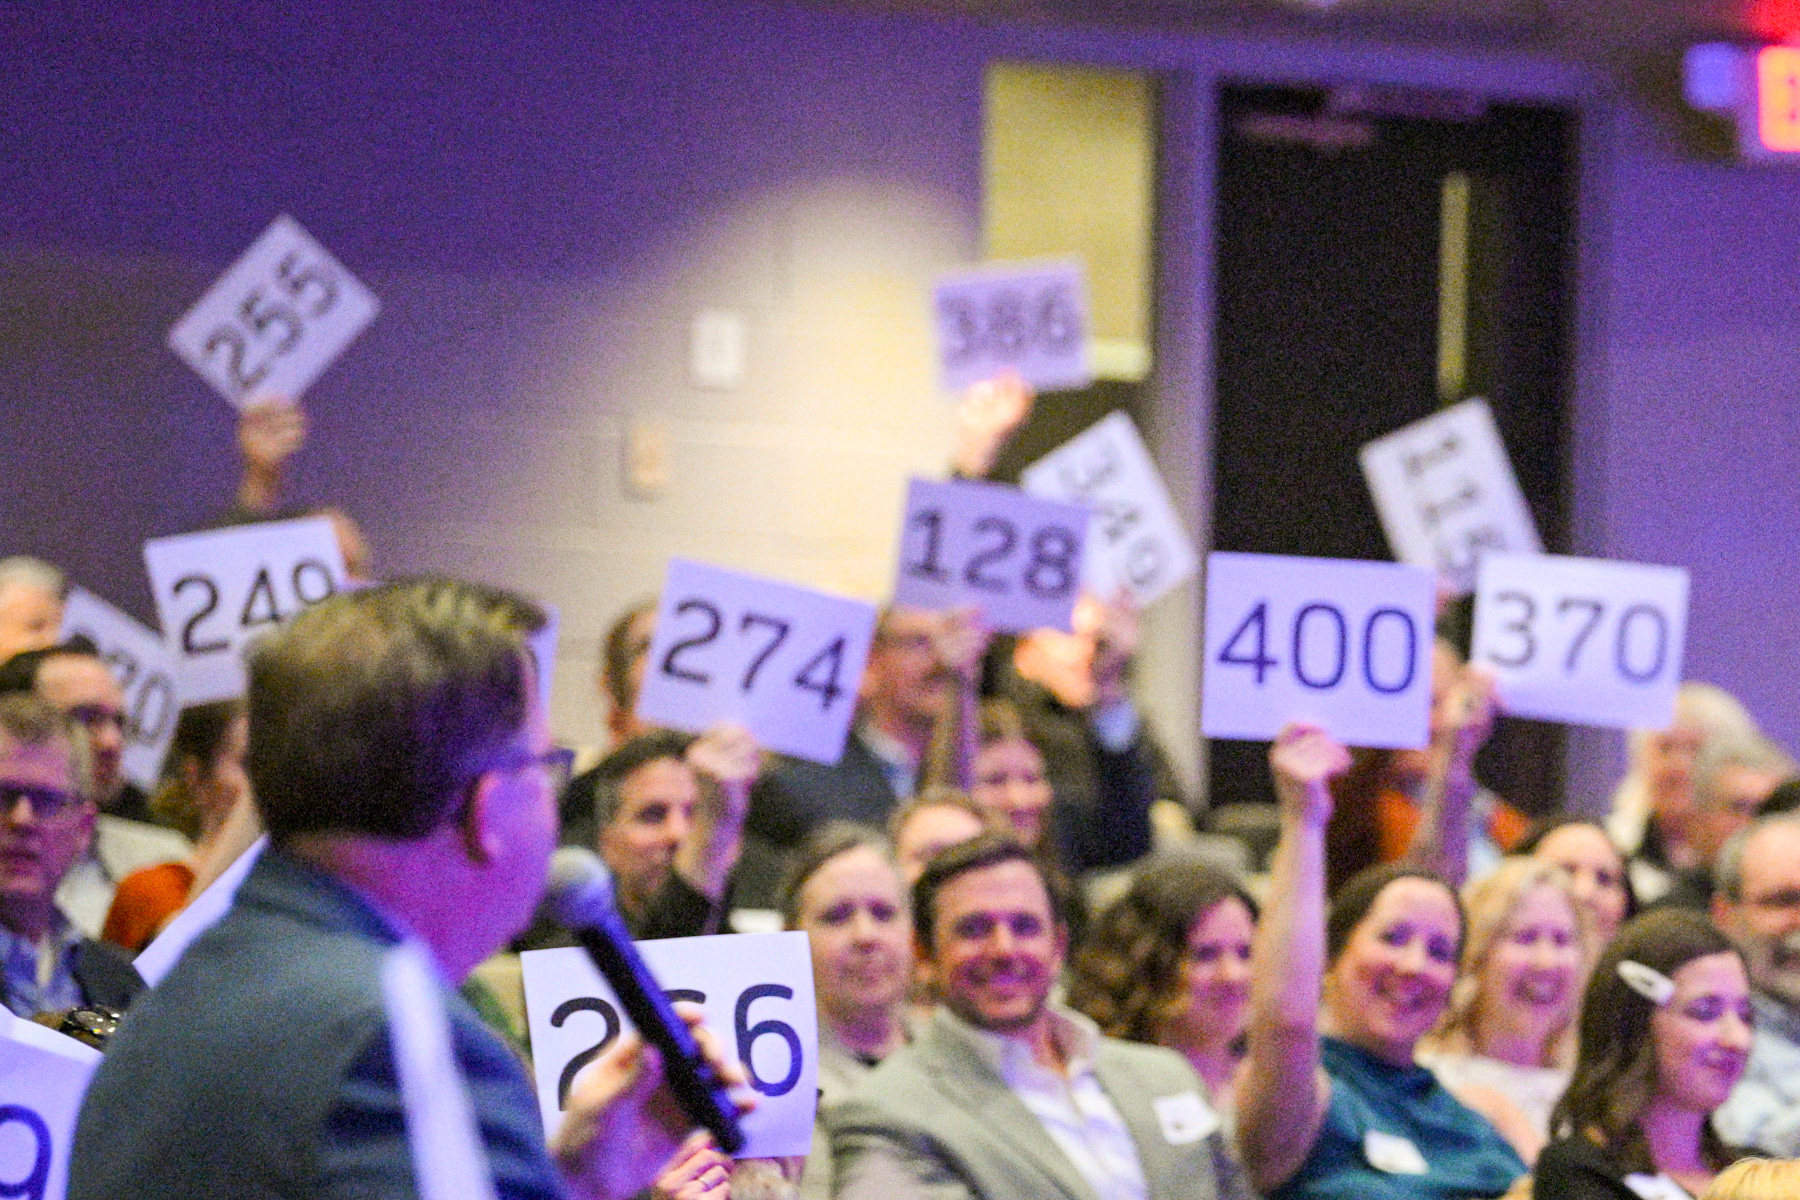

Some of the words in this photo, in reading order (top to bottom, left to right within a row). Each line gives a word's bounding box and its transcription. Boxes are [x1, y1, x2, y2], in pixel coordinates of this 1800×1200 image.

[205, 250, 340, 392] 255
[906, 507, 1081, 602] 128
[660, 598, 848, 712] 274
[1218, 602, 1417, 694] 400
[1485, 590, 1668, 684] 370
[549, 983, 803, 1112] 26
